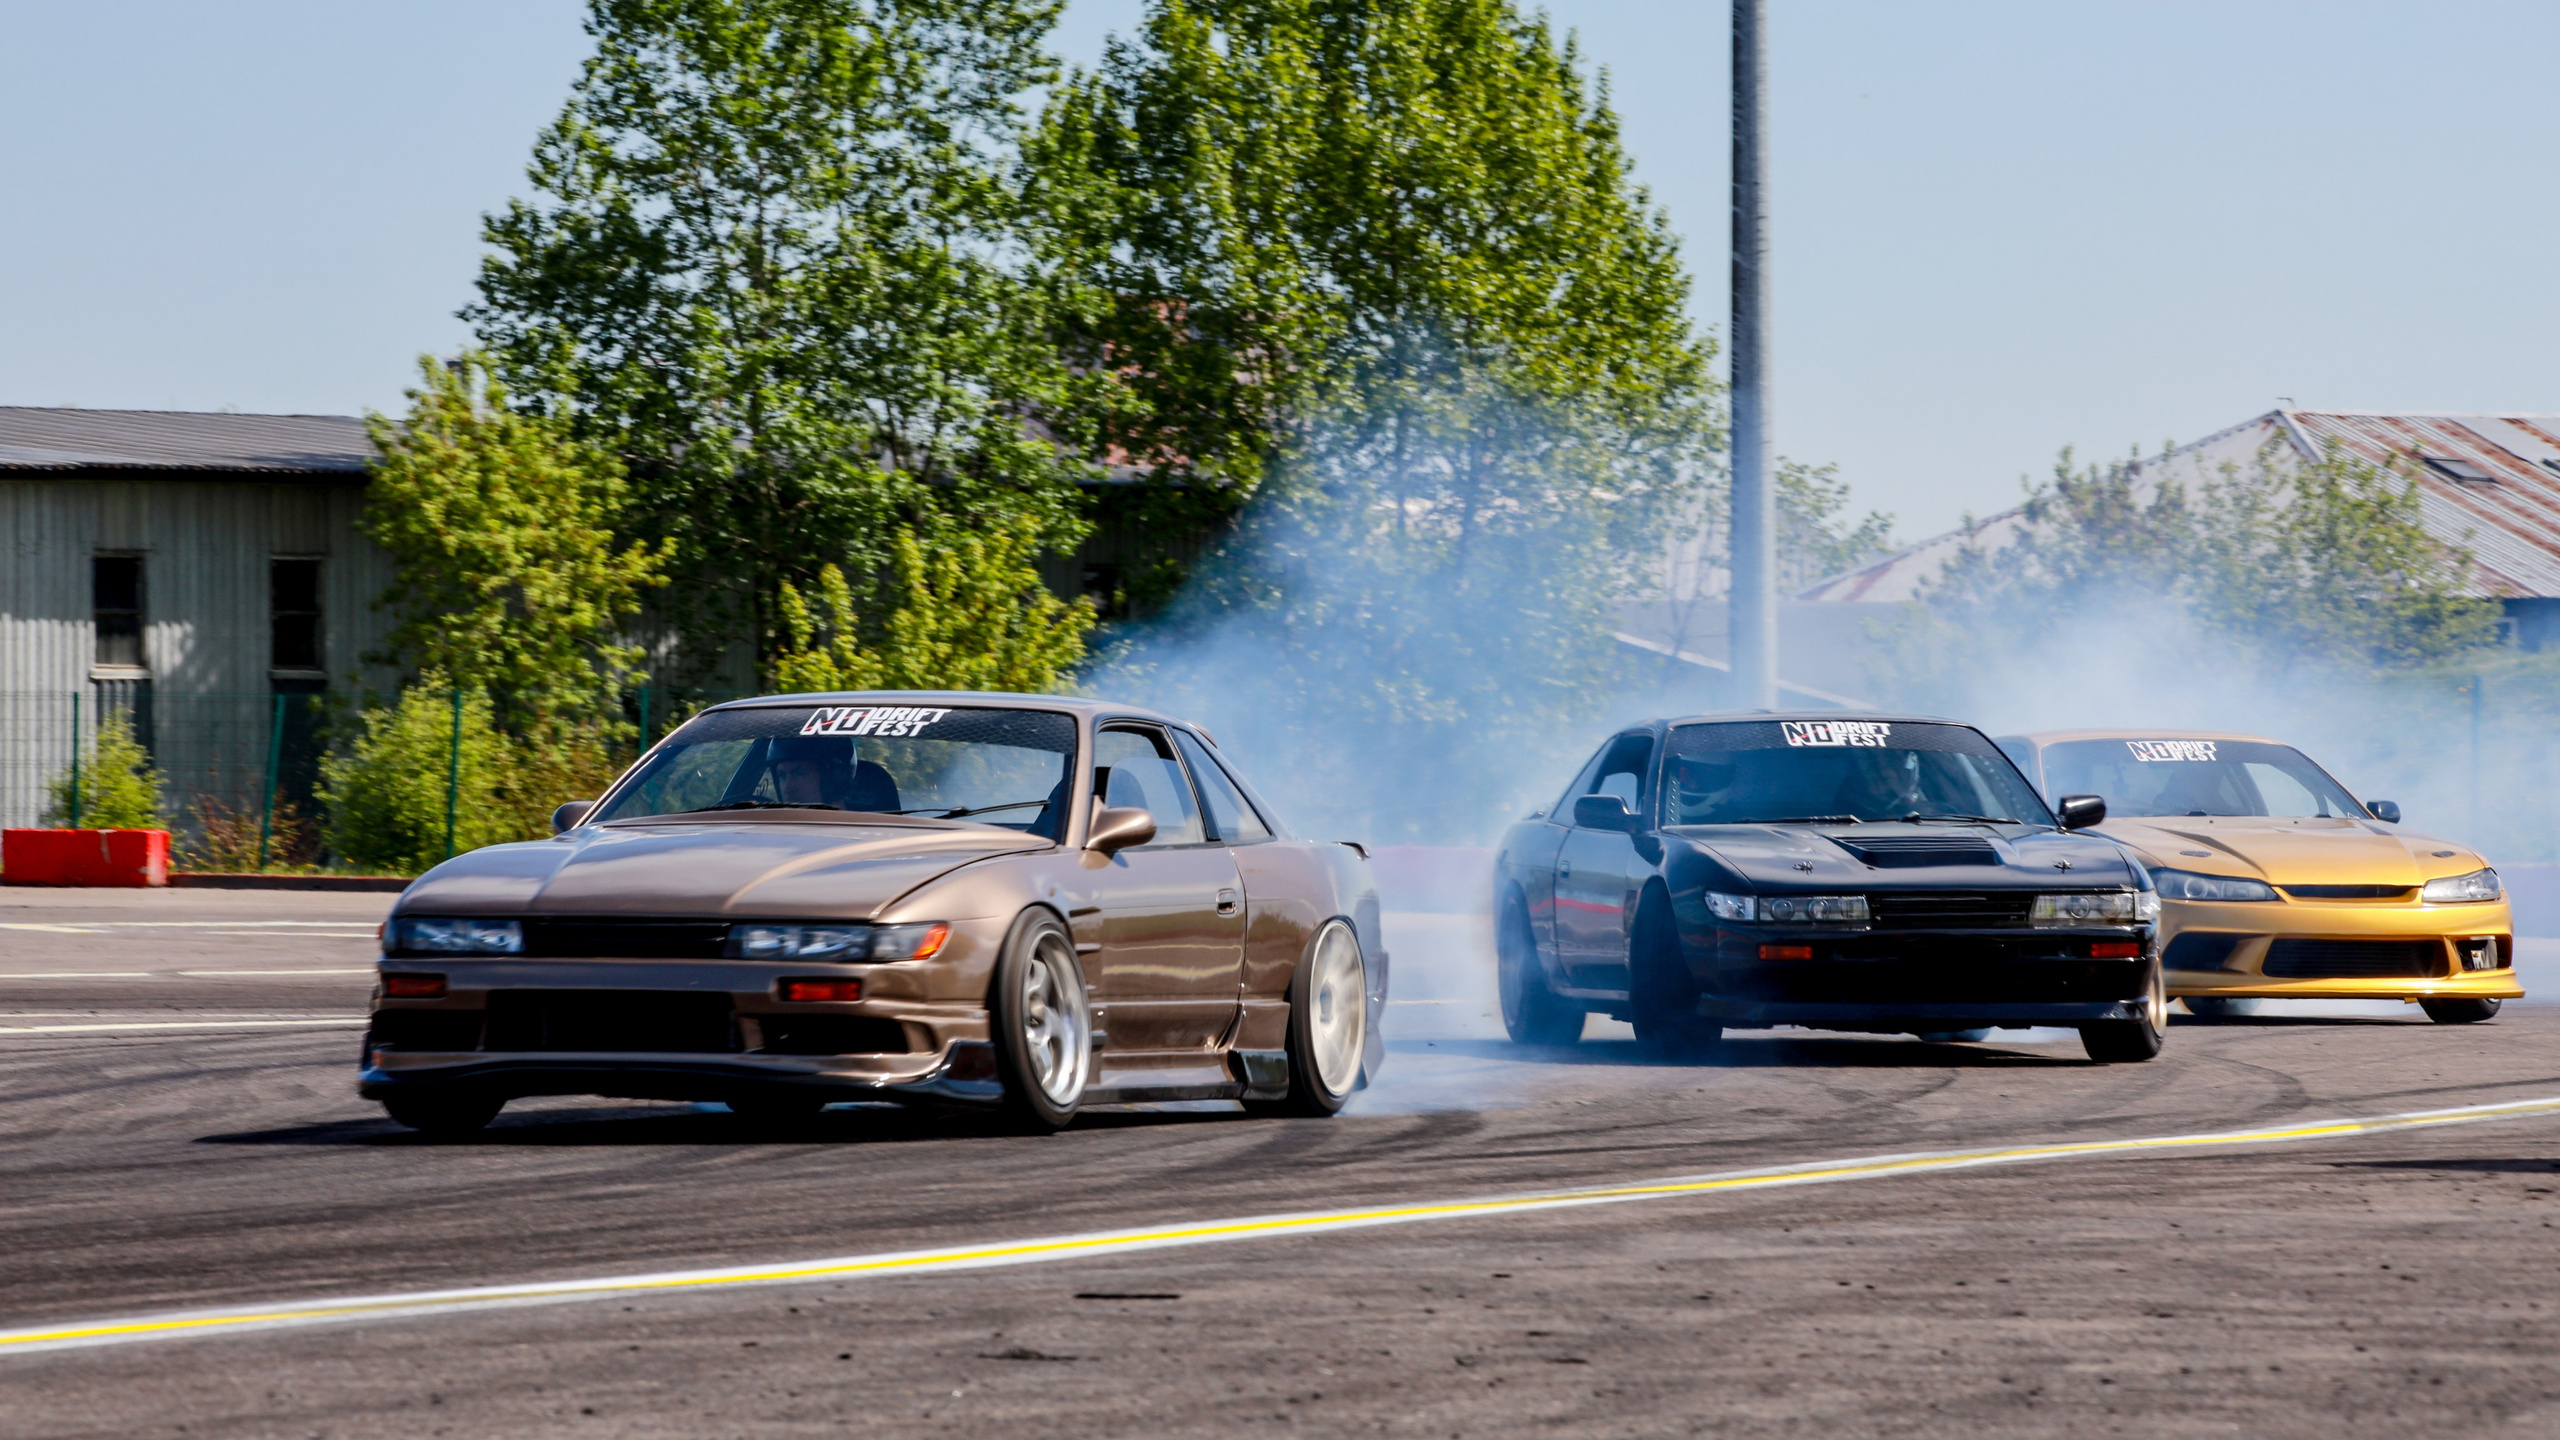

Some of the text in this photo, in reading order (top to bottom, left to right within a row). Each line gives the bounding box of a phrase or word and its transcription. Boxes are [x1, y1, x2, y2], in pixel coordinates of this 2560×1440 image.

[870, 707, 952, 723] DRIFT
[860, 720, 929, 737] FEST
[1831, 721, 1891, 735] DRIFT
[1835, 734, 1887, 747] FEST
[2168, 741, 2215, 752] DRIFT
[2173, 750, 2216, 762] FEST
